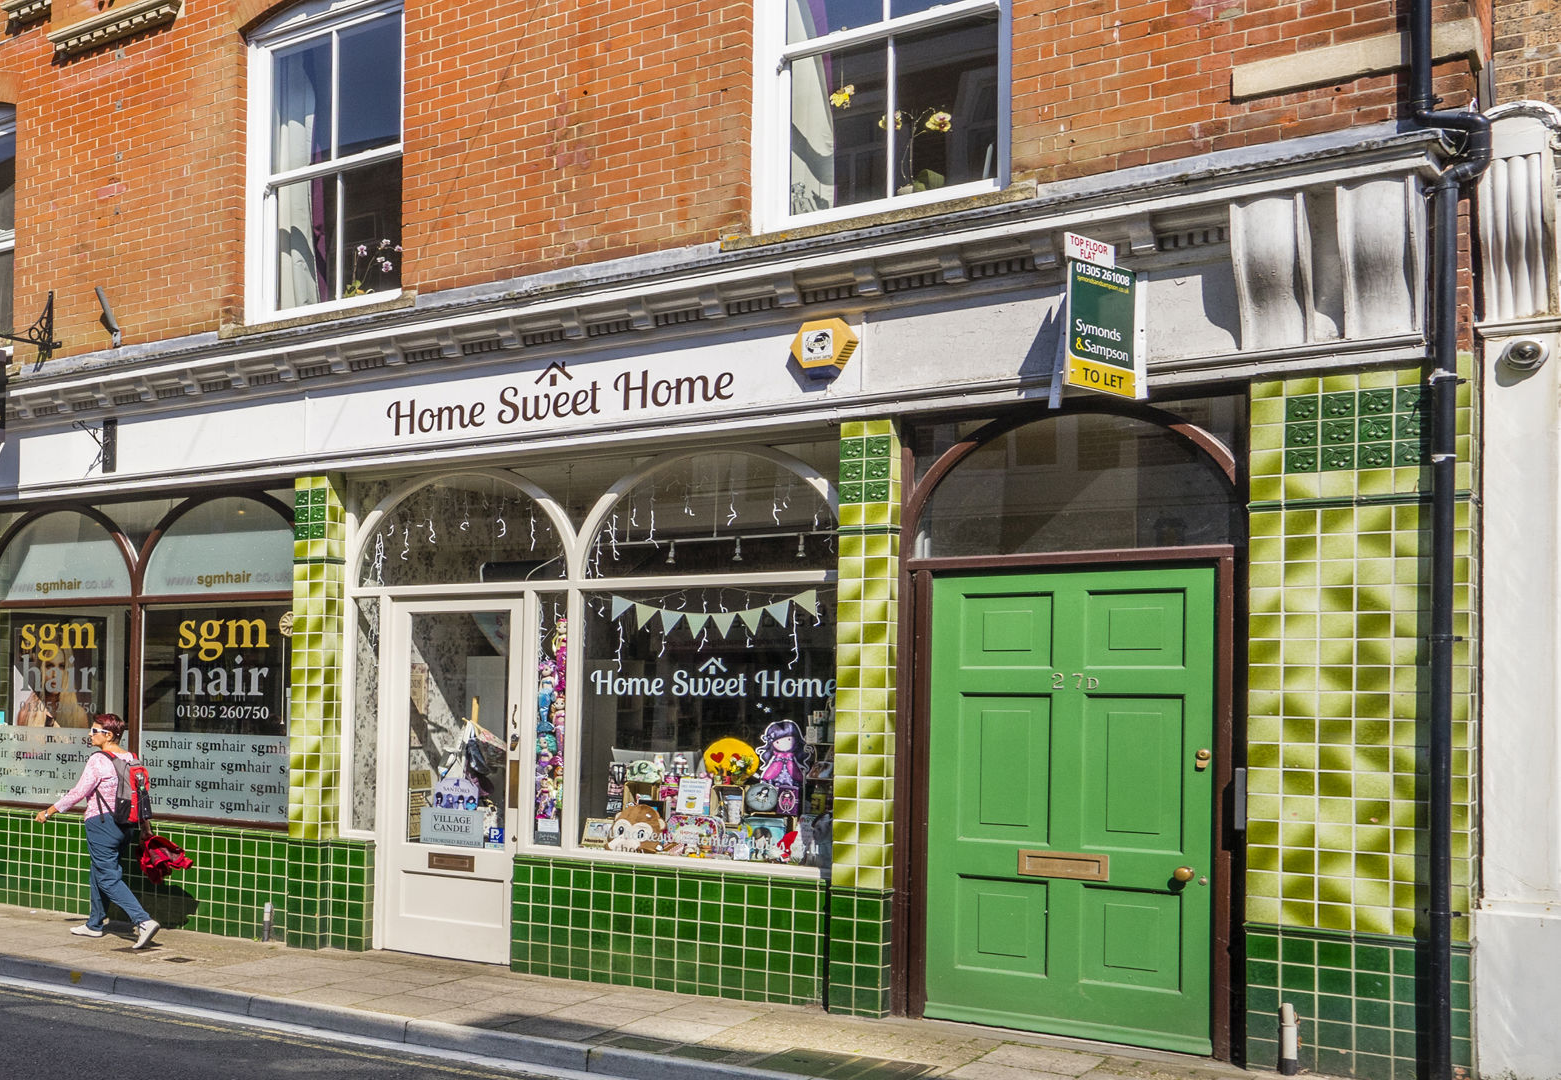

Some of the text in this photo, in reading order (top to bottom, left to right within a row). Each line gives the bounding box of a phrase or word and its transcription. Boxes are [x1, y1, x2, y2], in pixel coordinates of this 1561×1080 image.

[1070, 235, 1108, 256] TOP FLOOR
[1080, 248, 1096, 262] FLAT
[1076, 262, 1130, 287] 01305 261008
[1075, 319, 1122, 342] Symonds
[1082, 367, 1124, 389] TO LET
[386, 369, 734, 436] Home Sweet Home
[20, 622, 98, 662] sgm
[178, 618, 270, 662] sgm
[20, 654, 97, 693] hair
[177, 654, 269, 696] hair
[590, 669, 837, 698] Home Sweet Home
[176, 705, 269, 720] 01305 260750
[145, 737, 287, 756] sgmhair sgmhair sgmh
[167, 757, 215, 771] sgmhair
[221, 759, 272, 774] sgmhair
[195, 776, 245, 791] sgmhair
[443, 786, 471, 794] SANTORO
[166, 795, 214, 809] sgmhair
[220, 798, 270, 814] sgmhair
[433, 814, 472, 824] VILLAGE
[433, 823, 471, 833] CANDLE
